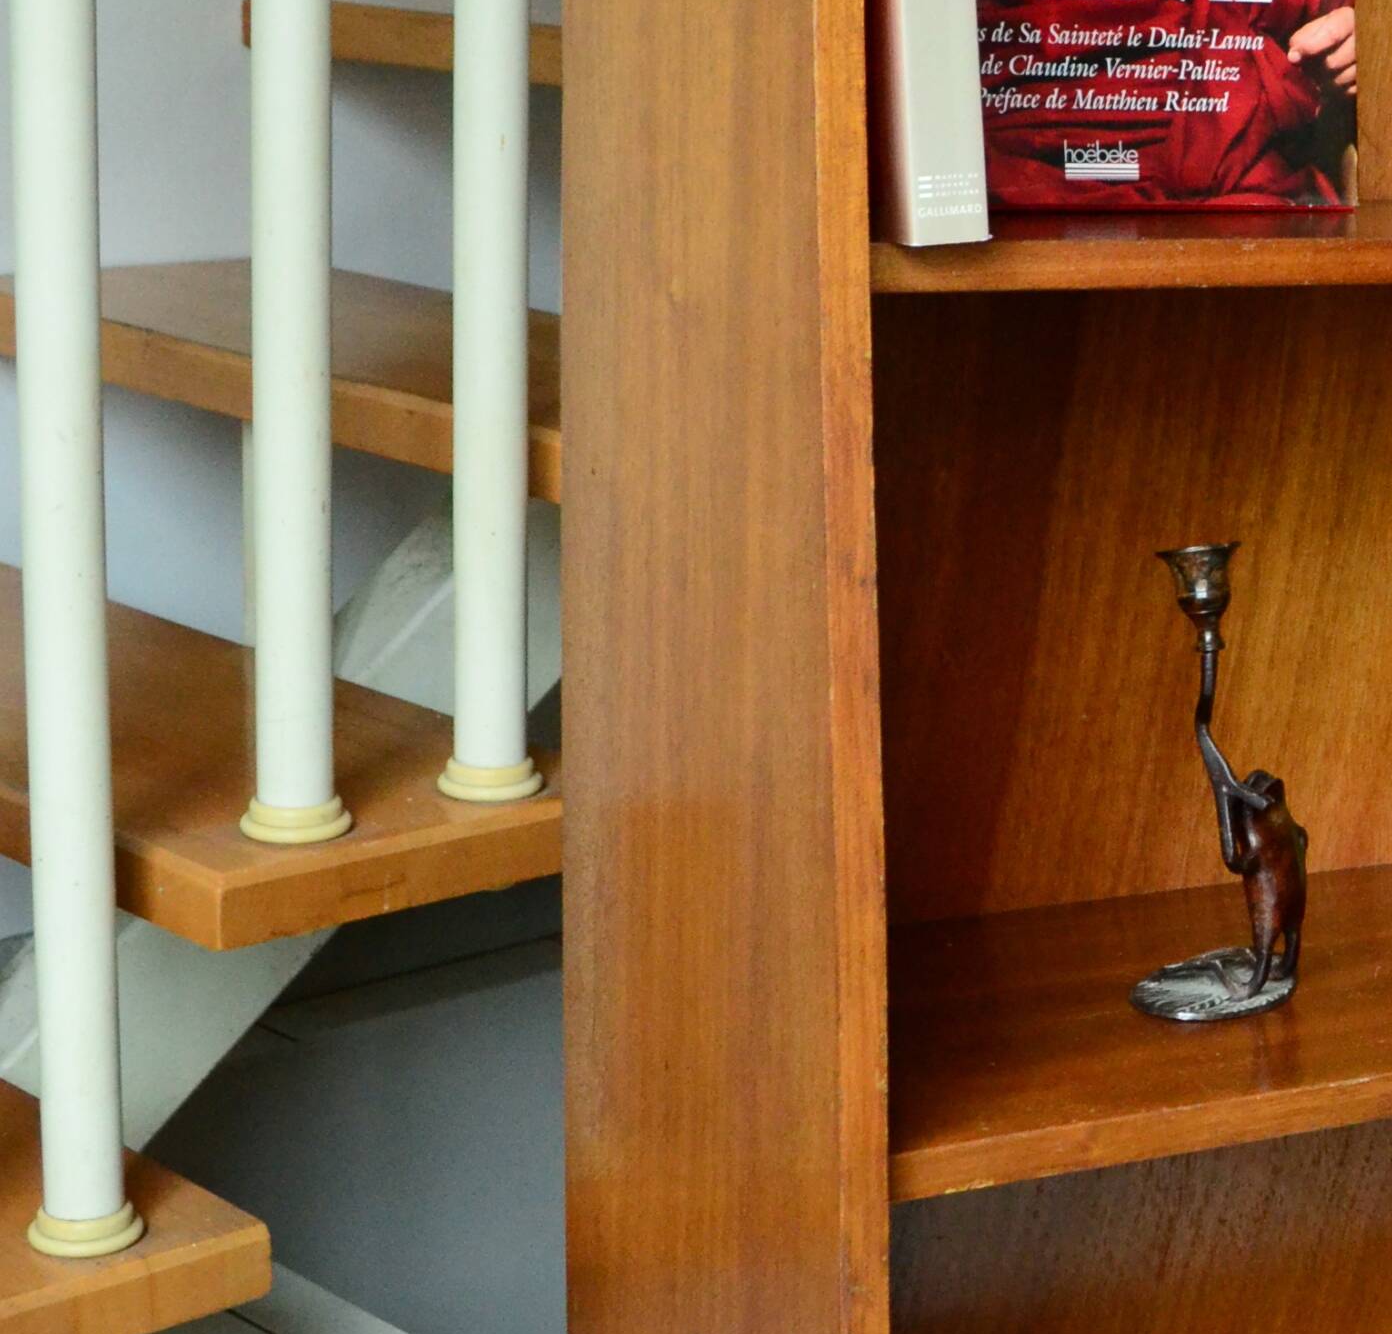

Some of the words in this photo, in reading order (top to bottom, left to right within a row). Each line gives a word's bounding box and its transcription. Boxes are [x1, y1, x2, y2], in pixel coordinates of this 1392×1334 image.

[977, 27, 987, 43] s
[990, 21, 1013, 43] de
[1018, 22, 1042, 44] Sa
[1048, 23, 1122, 47] Sainteté
[1127, 25, 1142, 47] le
[1148, 27, 1265, 51] Dalaï-Lama
[981, 54, 1003, 76] de
[1009, 54, 1098, 78] Claudine
[1104, 57, 1241, 82] Vernier-Palliez
[1045, 87, 1067, 110] de
[1072, 88, 1159, 112] Matthieu
[1164, 90, 1230, 113] Ricard
[1063, 139, 1139, 164] hoëbeke
